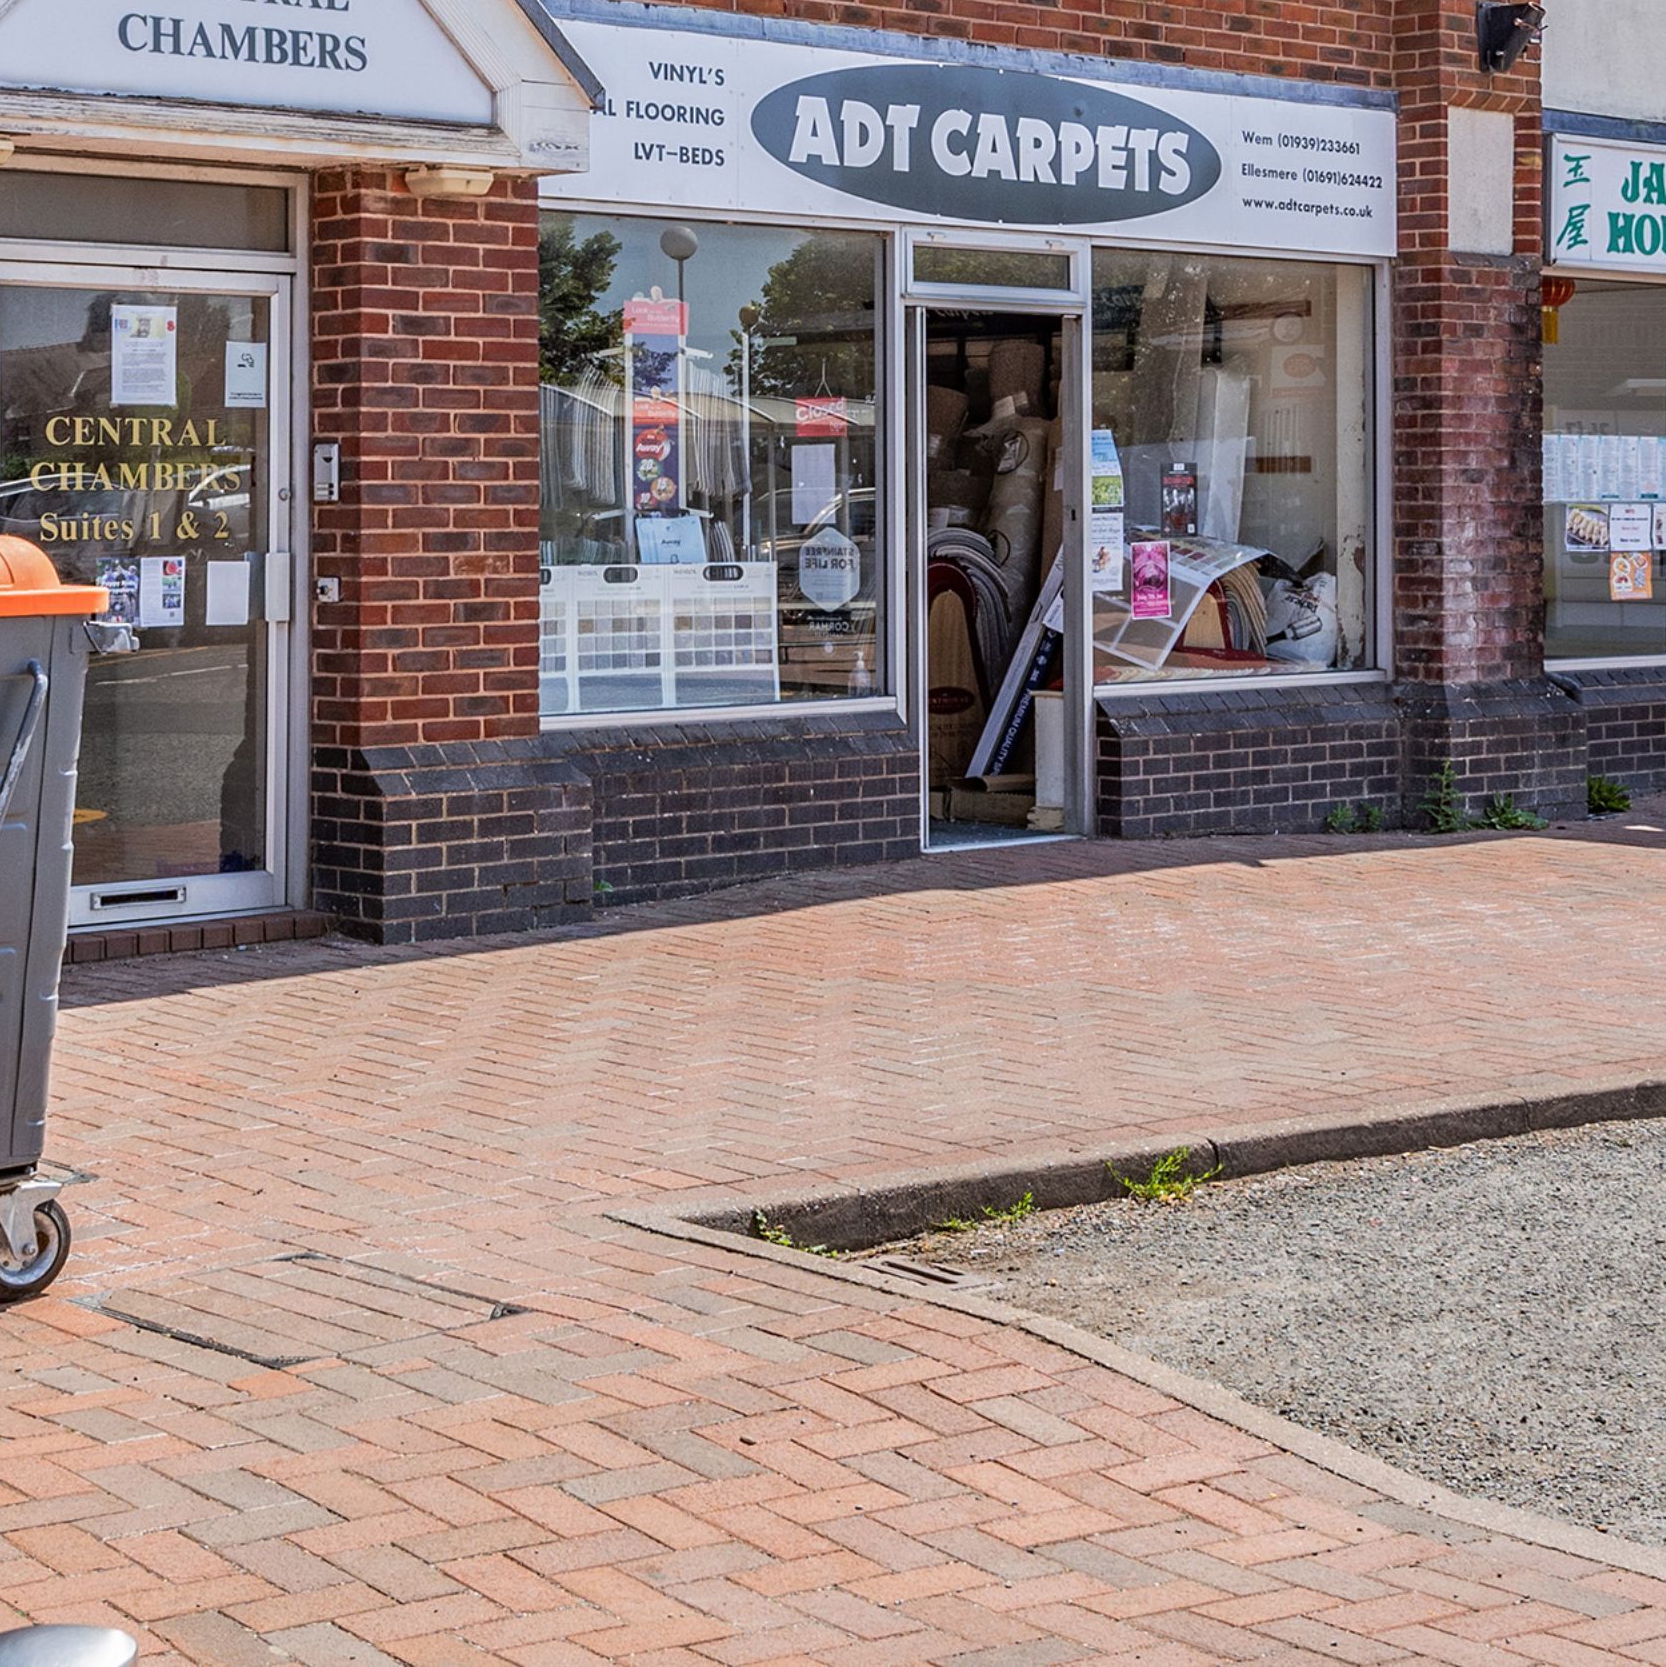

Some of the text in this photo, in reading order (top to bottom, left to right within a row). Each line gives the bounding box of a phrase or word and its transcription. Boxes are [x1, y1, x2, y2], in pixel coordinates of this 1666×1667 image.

[118, 13, 368, 72] CHAMBERS
[648, 61, 725, 86] VINYL'S
[626, 100, 725, 126] FLOORING
[788, 95, 1191, 195] ADT CARPETS
[1242, 130, 1360, 155] Wem (01939)233661
[1241, 163, 1383, 189] Ellesmere (01691)624422
[1242, 197, 1373, 218] www.adtcarpets.co.uk
[45, 416, 227, 447] CENTRAL
[30, 462, 241, 492] CHAMBERS
[39, 511, 230, 542] Suites 1 & 2
[996, 726, 1019, 763] QUALITY
